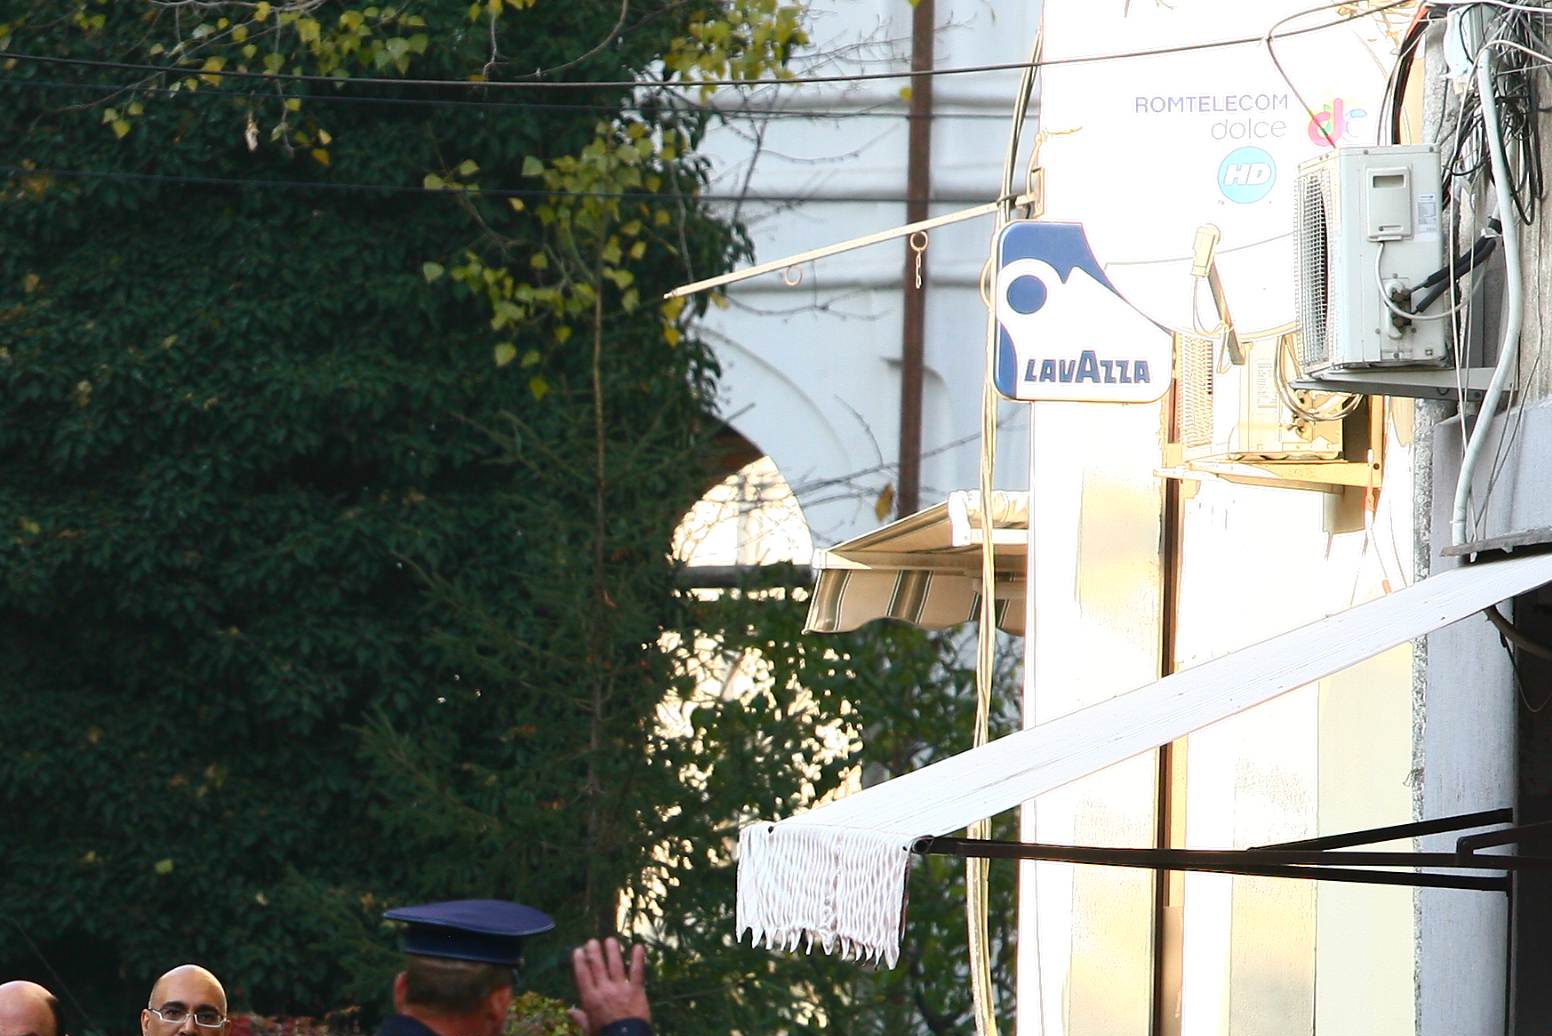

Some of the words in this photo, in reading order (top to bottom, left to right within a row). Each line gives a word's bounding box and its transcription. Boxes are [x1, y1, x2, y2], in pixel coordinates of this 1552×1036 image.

[1135, 93, 1288, 113] ROMTELECOM
[1211, 118, 1287, 140] dolce
[1223, 162, 1273, 186] HD
[1024, 350, 1151, 384] LAVAZZA
